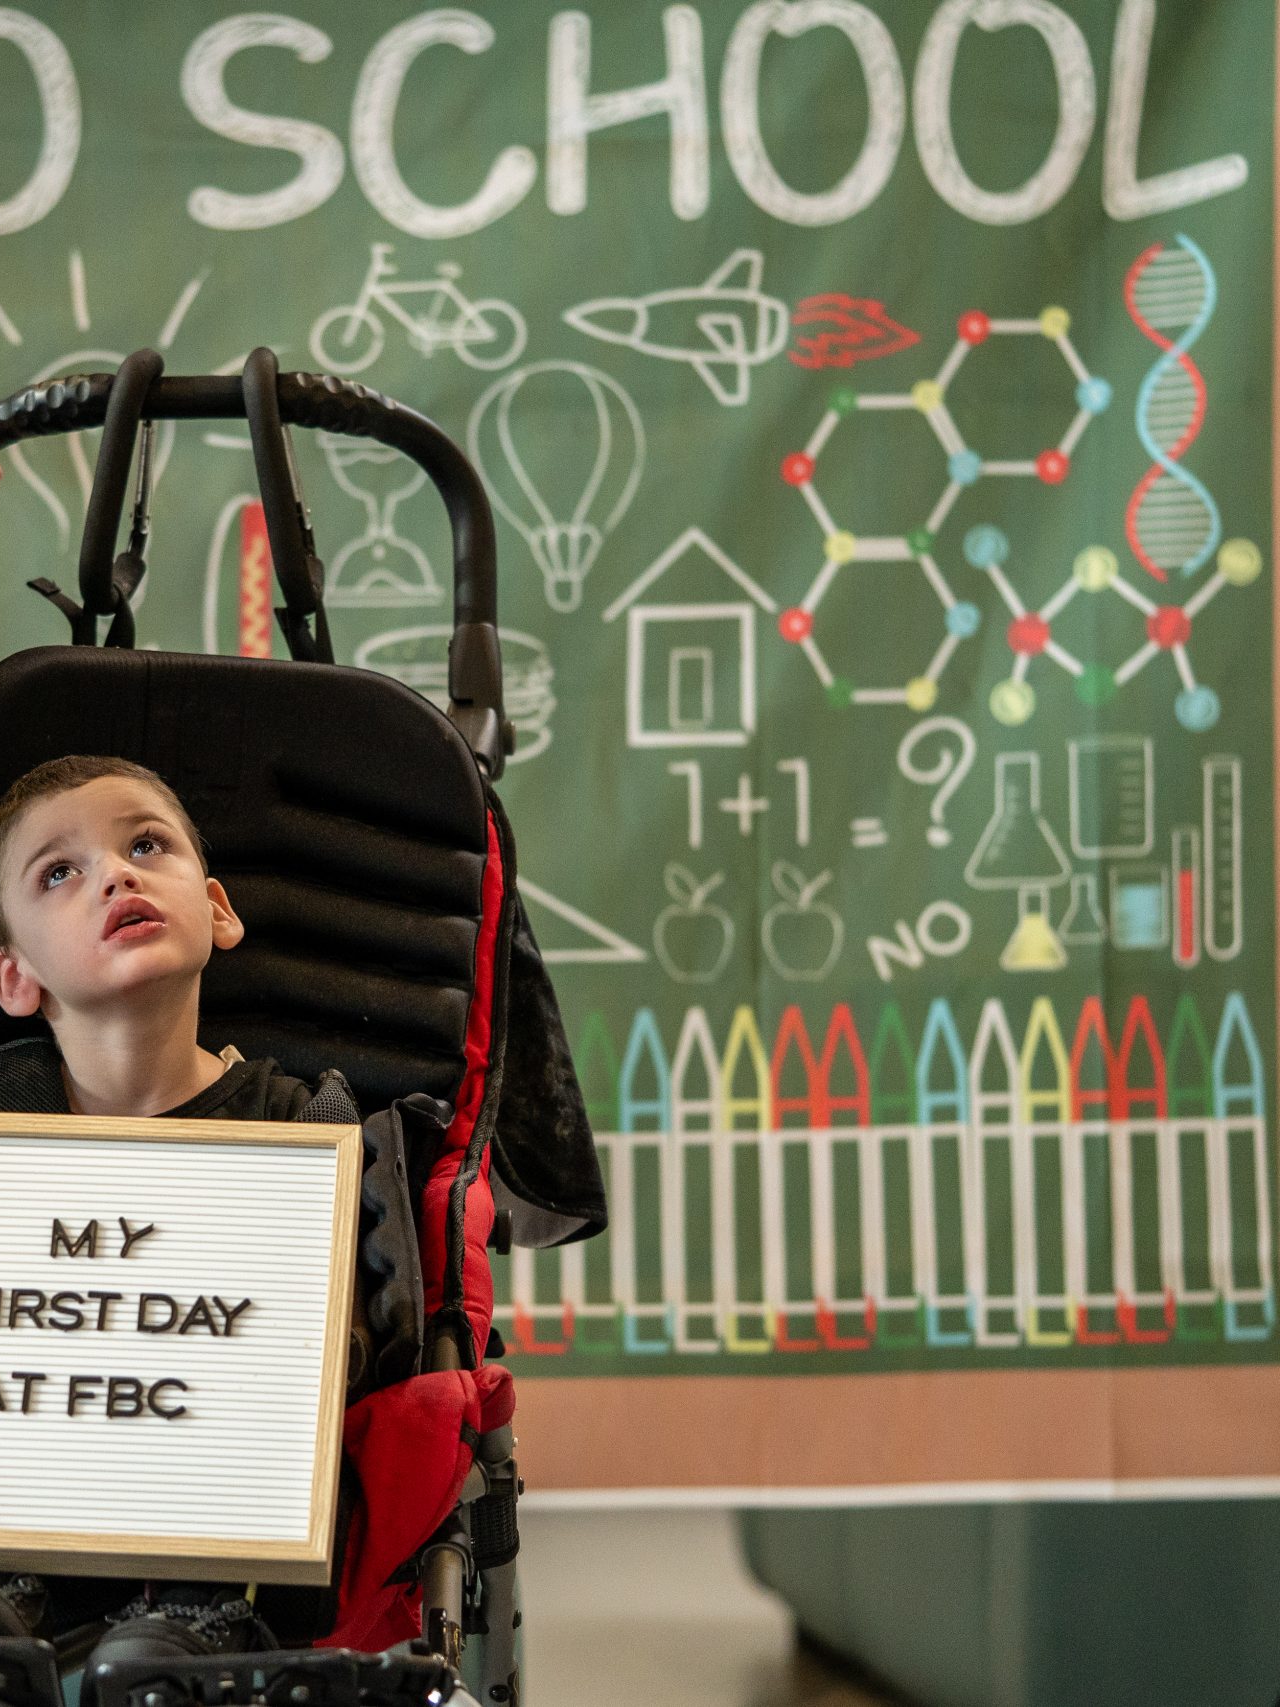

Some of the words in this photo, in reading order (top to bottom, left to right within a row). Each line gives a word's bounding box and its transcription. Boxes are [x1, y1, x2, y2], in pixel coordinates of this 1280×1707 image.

[180, 0, 1249, 240] SCHOOL
[866, 900, 972, 982] NO
[137, 1292, 251, 1337] DAY
[67, 1375, 188, 1420] FBC
